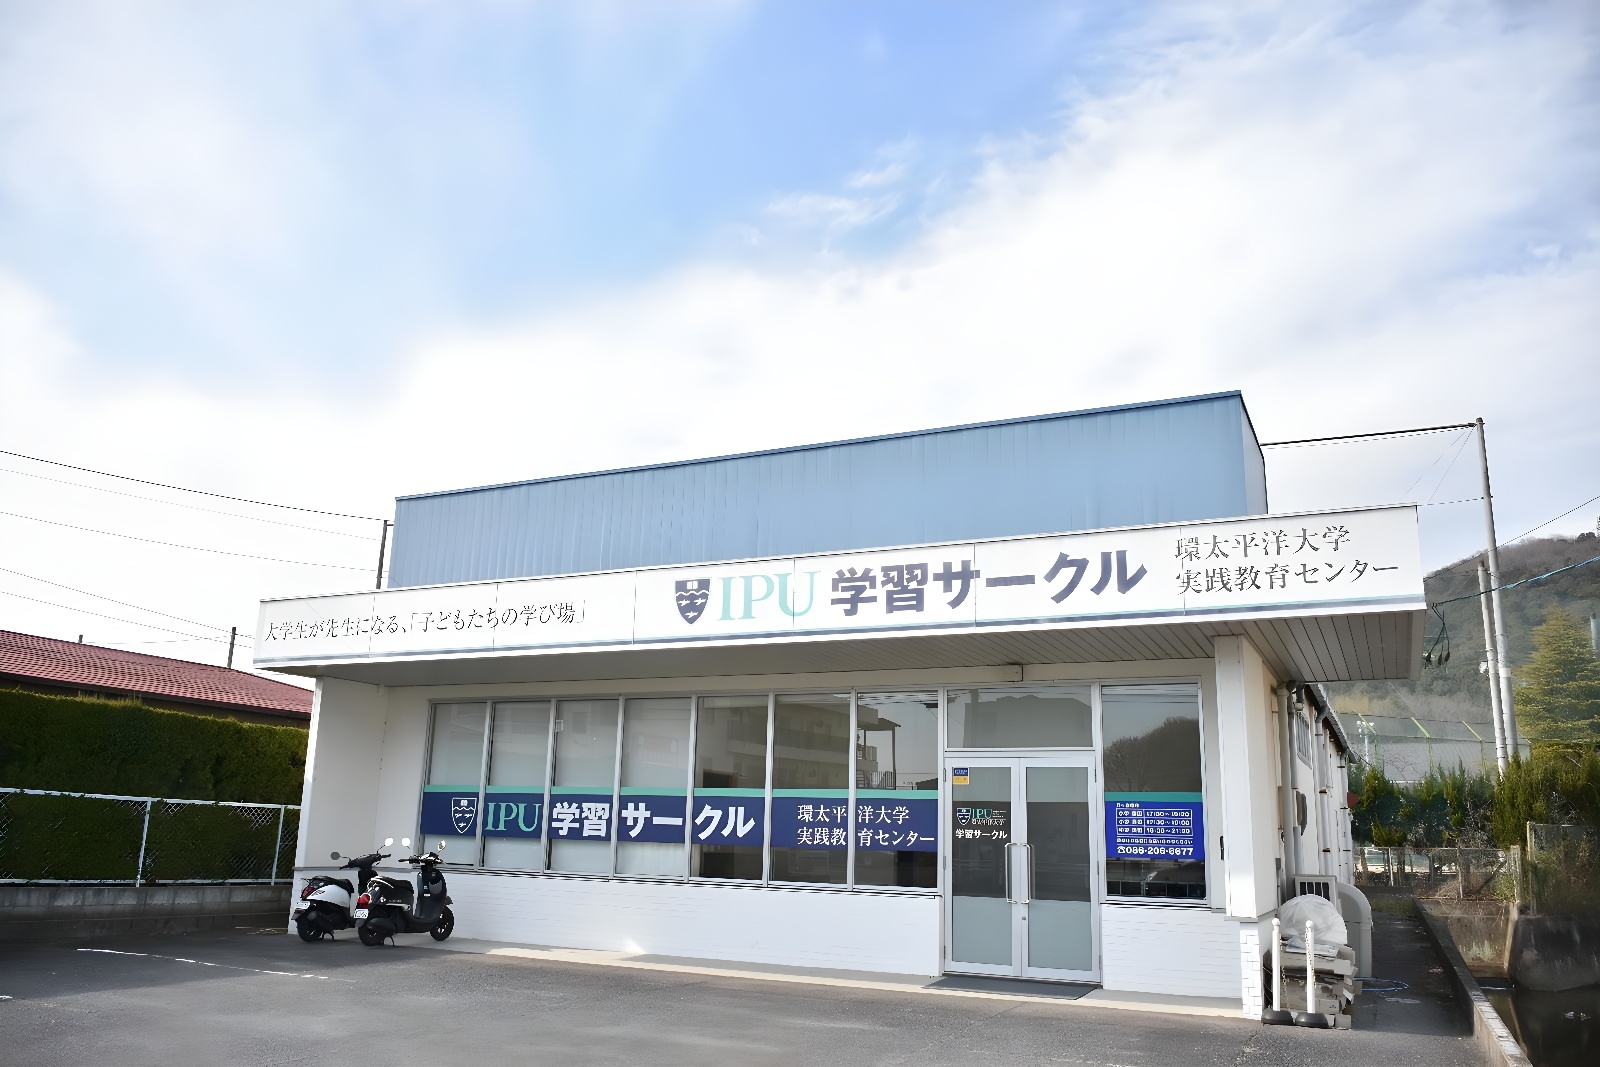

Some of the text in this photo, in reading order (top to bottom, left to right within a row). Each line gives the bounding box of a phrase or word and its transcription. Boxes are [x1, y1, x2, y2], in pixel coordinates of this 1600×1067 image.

[1175, 525, 1351, 562] 環太平洋大学
[716, 549, 1148, 621] IPU 学習サークル
[1175, 559, 1399, 595] 実践教育センター
[484, 802, 542, 832] IPU
[955, 829, 1008, 840] 学習サークル
